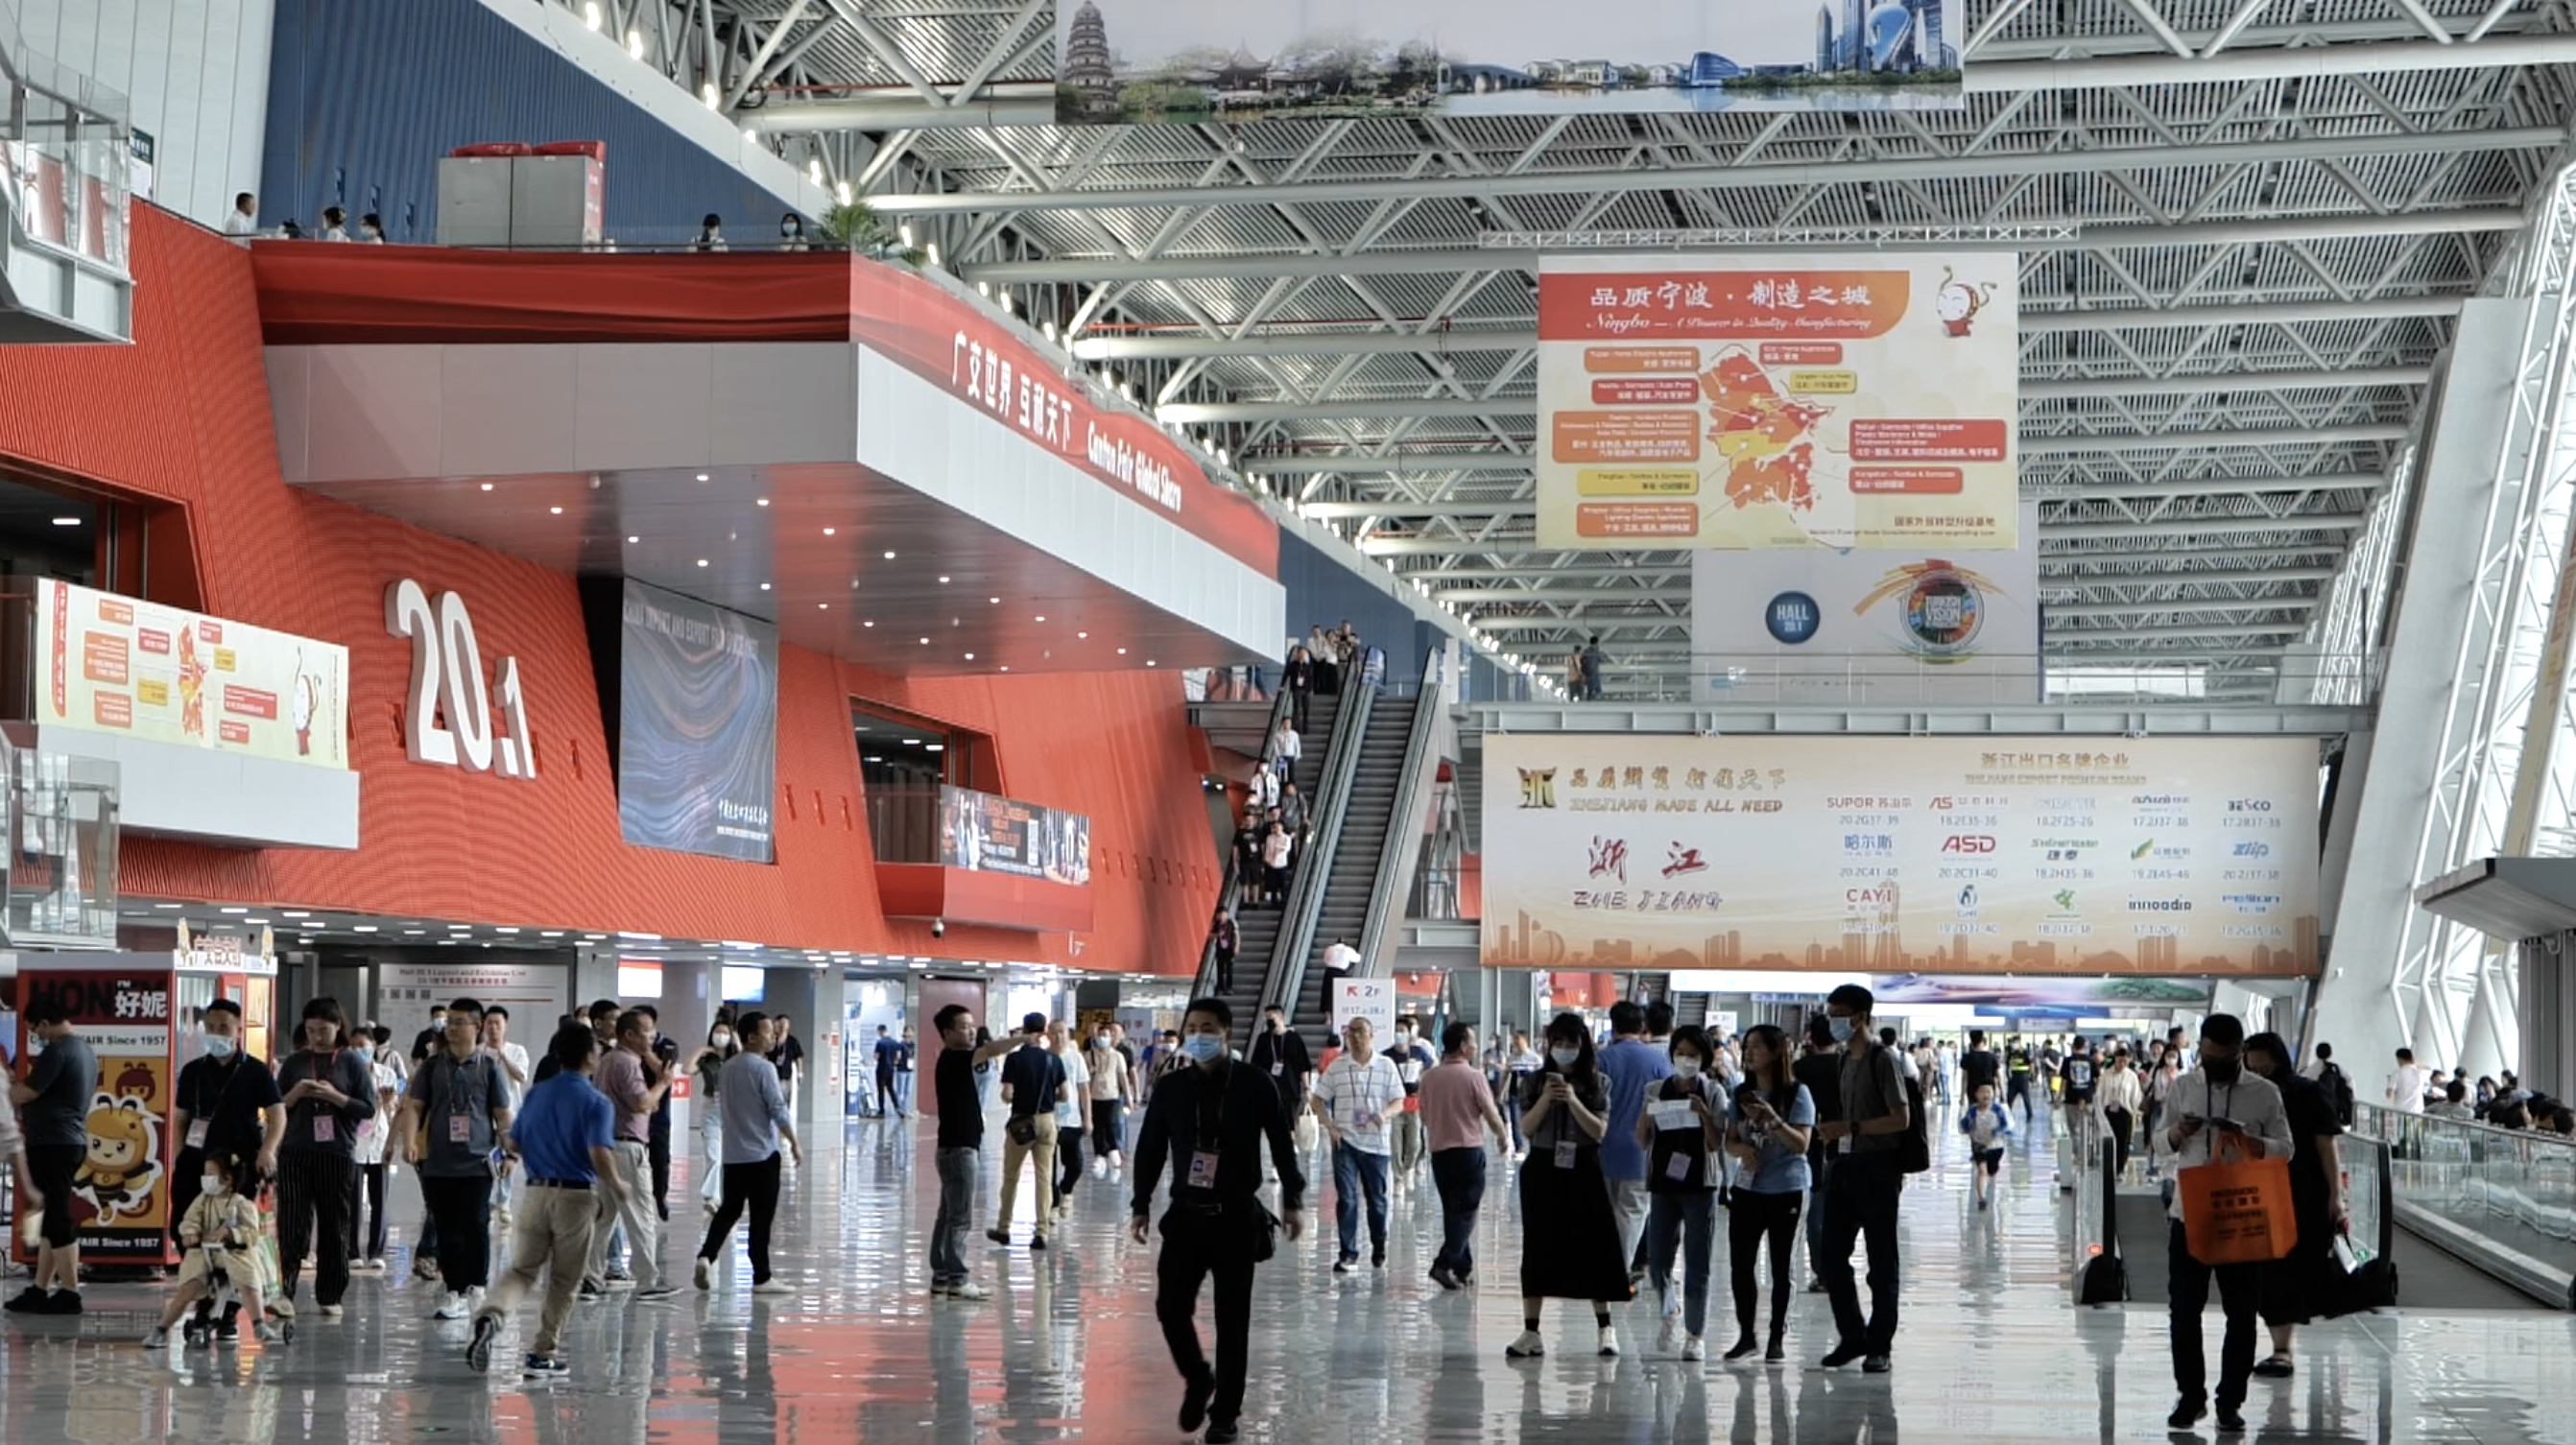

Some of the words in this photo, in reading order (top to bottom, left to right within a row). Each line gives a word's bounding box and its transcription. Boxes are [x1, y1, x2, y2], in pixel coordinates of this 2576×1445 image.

[1586, 312, 1650, 333] Ningbo
[952, 329, 1012, 417] 广交世界
[1087, 419, 1116, 476] Canton
[1117, 438, 1133, 486] Fair
[1134, 450, 1160, 501] Global
[1777, 604, 1809, 621] HALL
[386, 578, 537, 780] 20.1
[1654, 799, 1697, 813] MADE
[1704, 799, 1734, 813] ALL
[1740, 799, 1783, 813] NEED
[1826, 796, 1874, 809] SUPOR
[1844, 835, 1893, 850] 哈尔斯
[1941, 835, 1996, 853] ASD
[1587, 834, 1709, 885] 浙江
[1364, 985, 1381, 997] 2F
[114, 990, 168, 1018] 好妮
[83, 1035, 104, 1044] AIR
[107, 1034, 136, 1045] Since
[141, 1035, 166, 1045] 1957
[102, 1237, 131, 1247] Since
